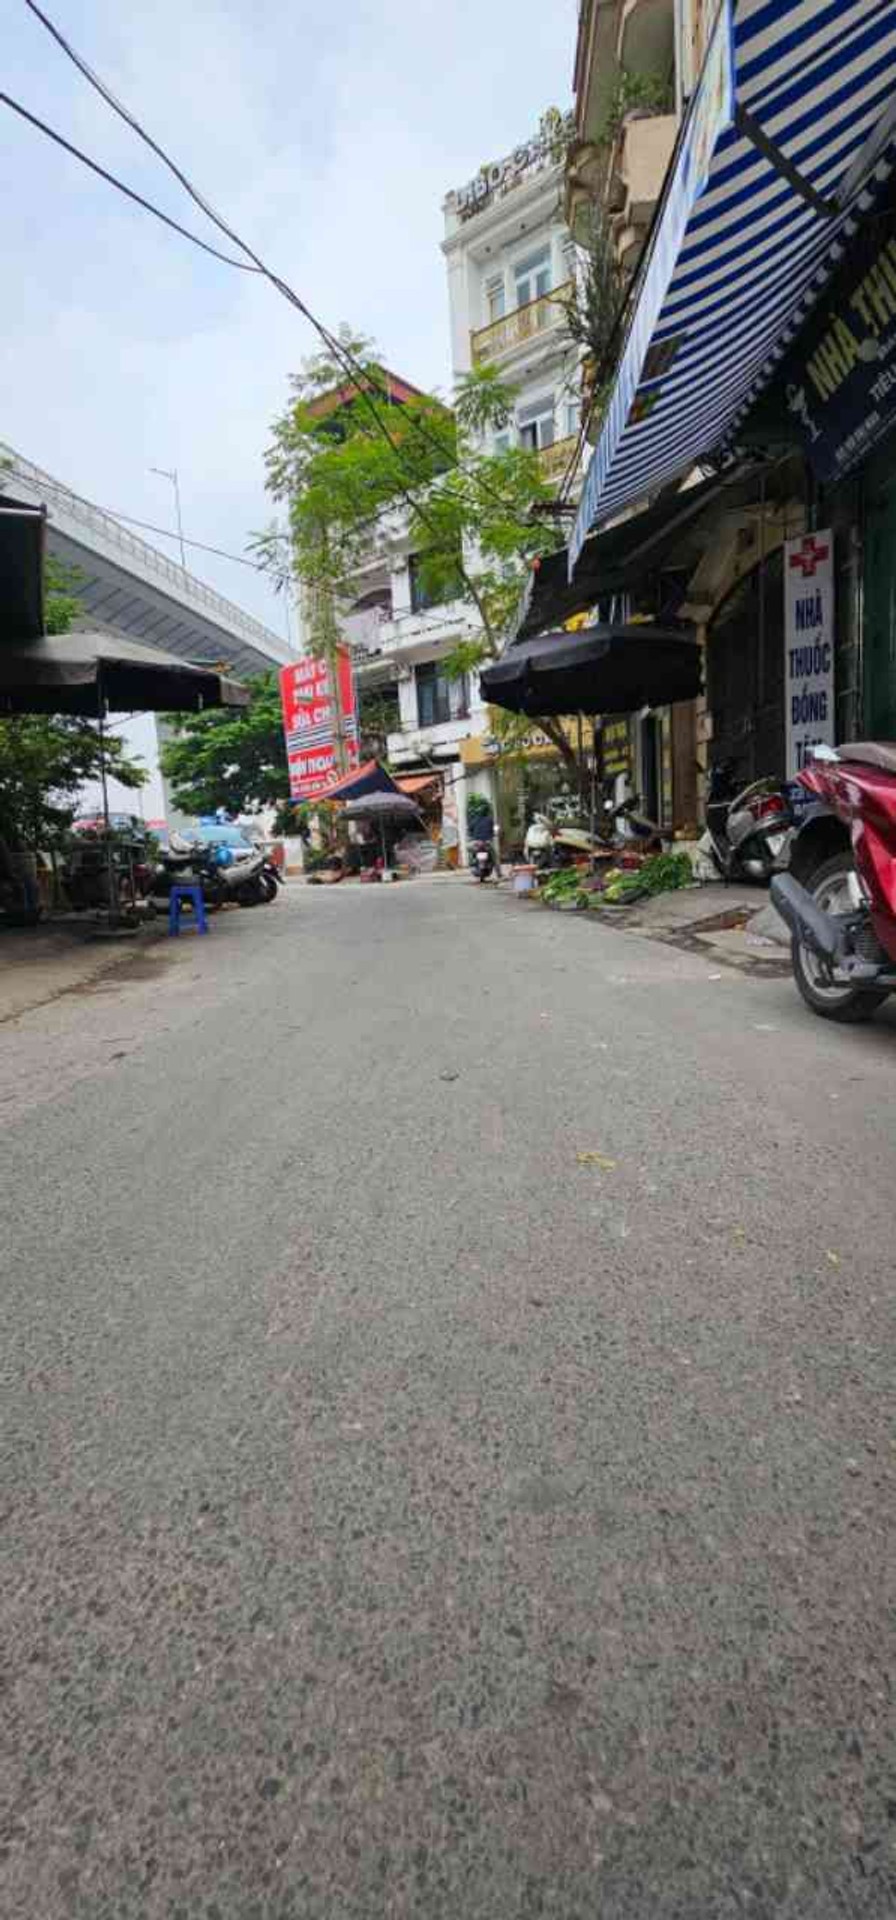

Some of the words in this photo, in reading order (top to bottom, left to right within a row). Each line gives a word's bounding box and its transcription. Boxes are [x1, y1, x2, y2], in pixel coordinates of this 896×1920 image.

[806, 312, 860, 402] NHÀ
[795, 588, 823, 630] NHÀ
[789, 632, 832, 679] THUỐC
